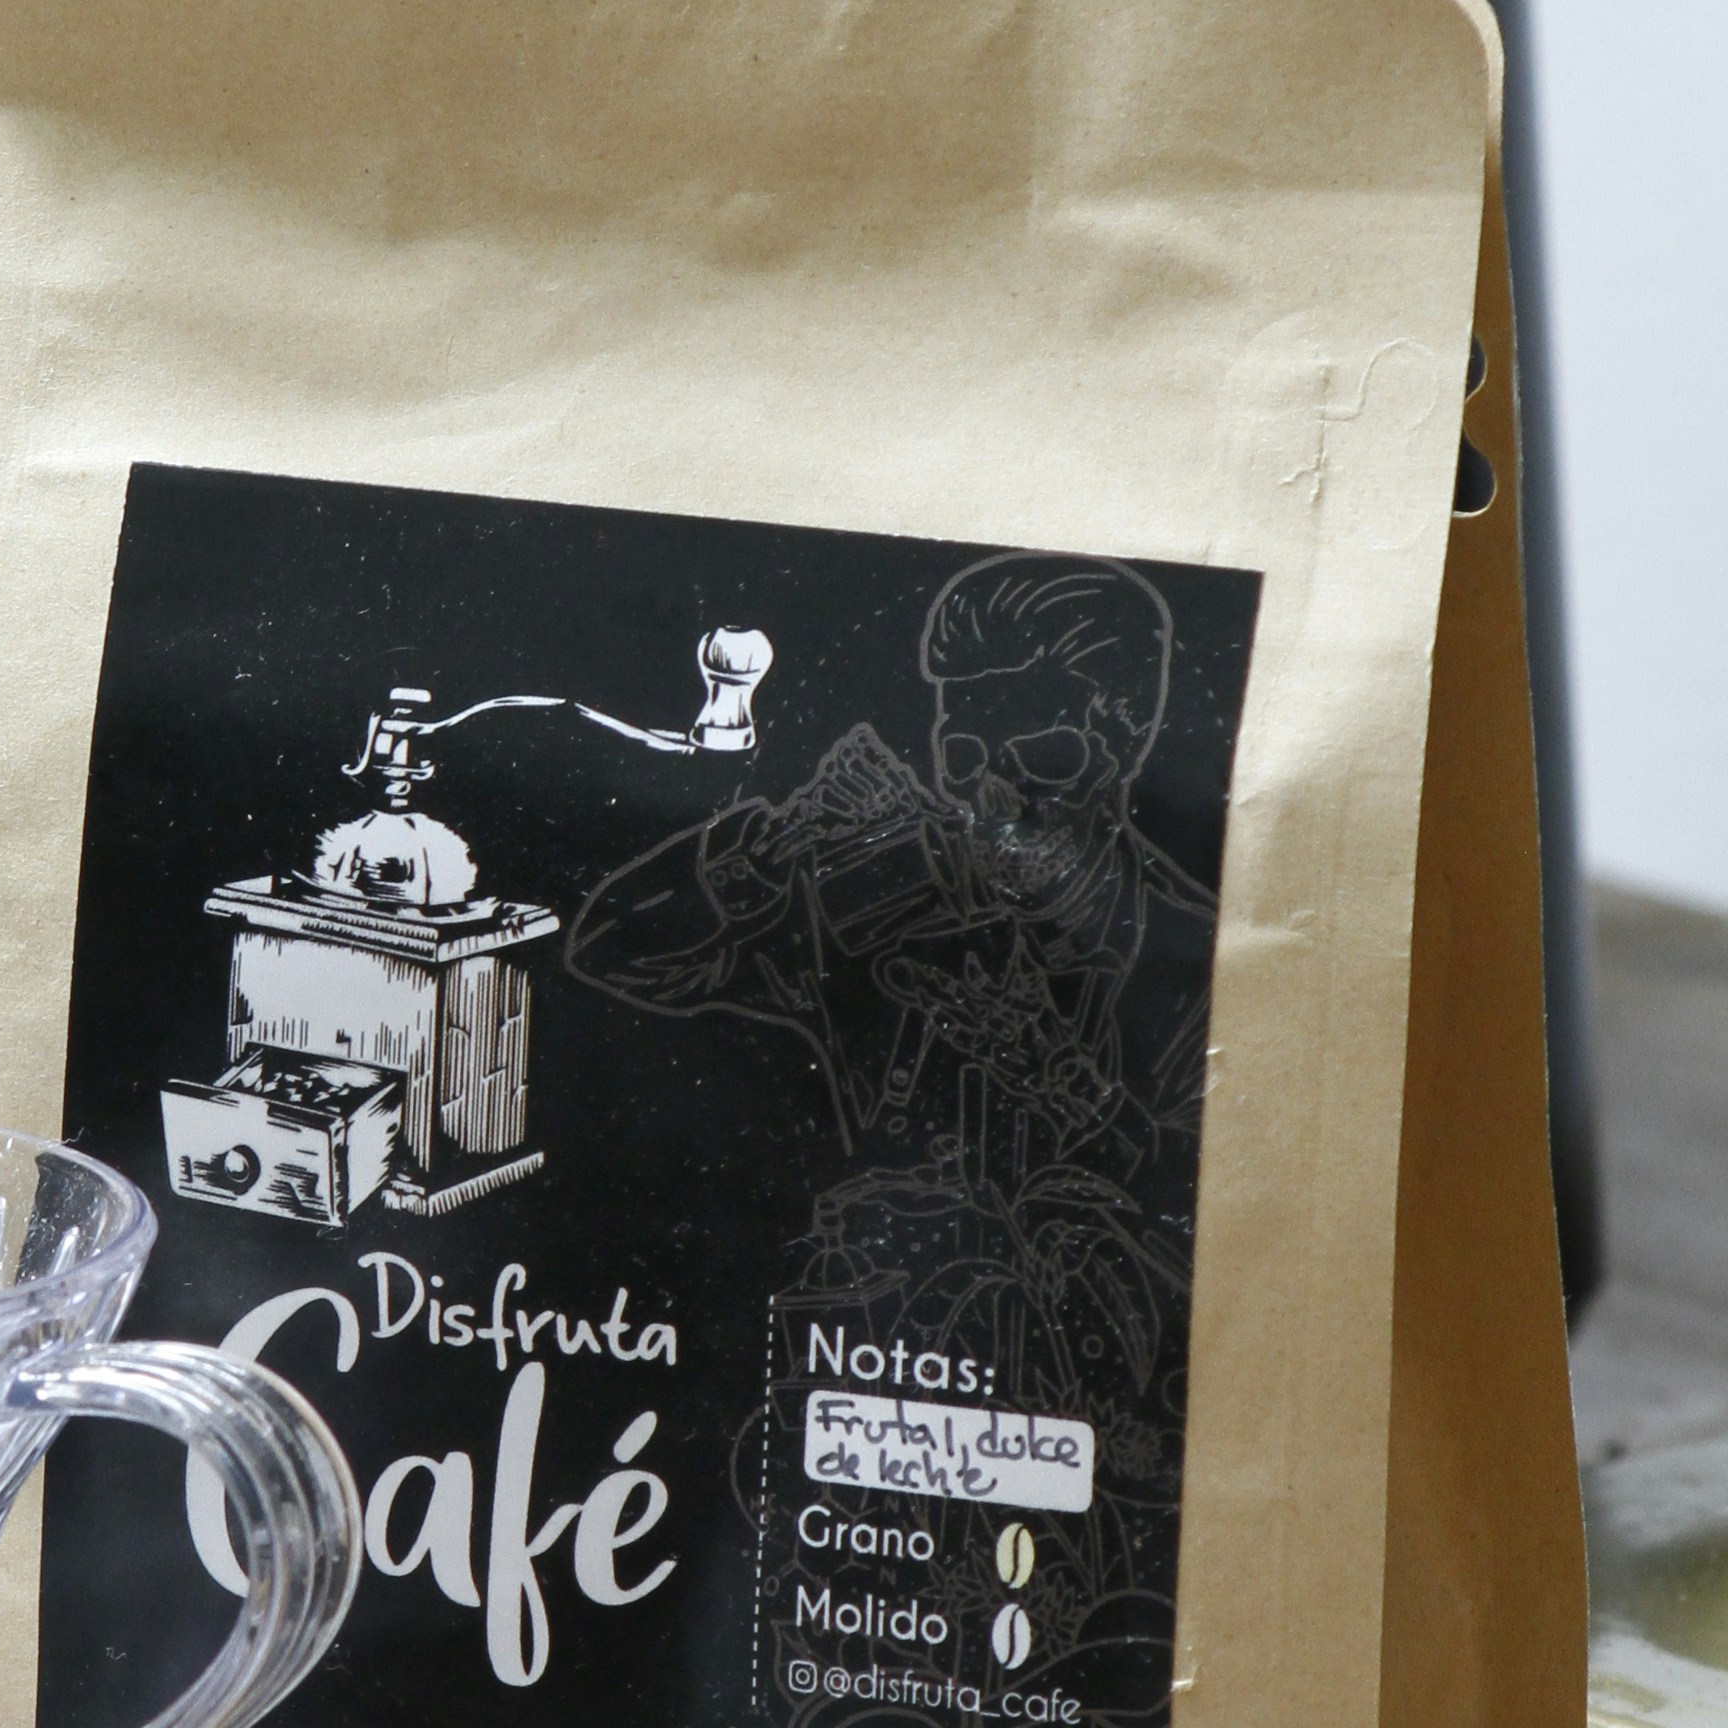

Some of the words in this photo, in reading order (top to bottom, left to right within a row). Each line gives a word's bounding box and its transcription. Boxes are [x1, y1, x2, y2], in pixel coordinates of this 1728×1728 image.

[357, 1251, 678, 1372] Disfruta
[807, 1322, 996, 1397] Notas:
[184, 1286, 678, 1688] Café
[797, 1504, 936, 1561] Grano
[795, 1584, 949, 1645] Molido
[823, 1663, 1082, 1726] @disfruta_cafe
